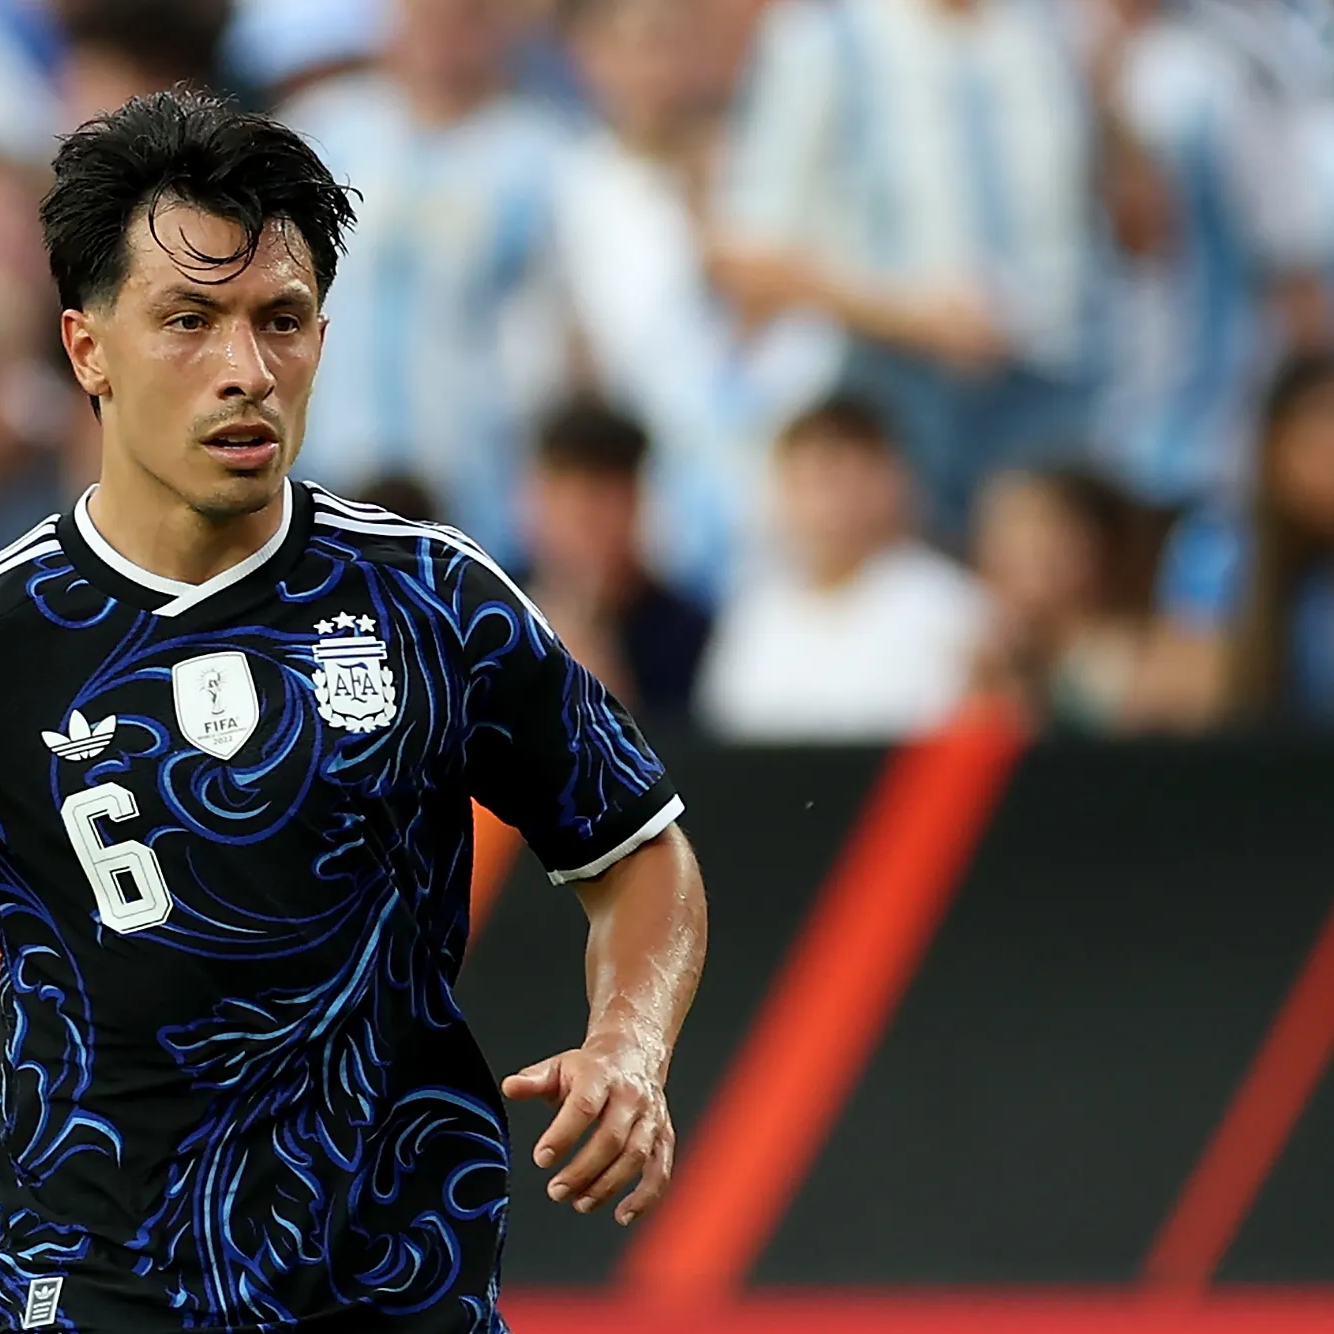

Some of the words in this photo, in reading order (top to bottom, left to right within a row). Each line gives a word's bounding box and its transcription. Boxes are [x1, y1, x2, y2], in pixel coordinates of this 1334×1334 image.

[334, 662, 379, 704] AFA
[204, 717, 238, 734] FIFA
[60, 781, 174, 935] 6
